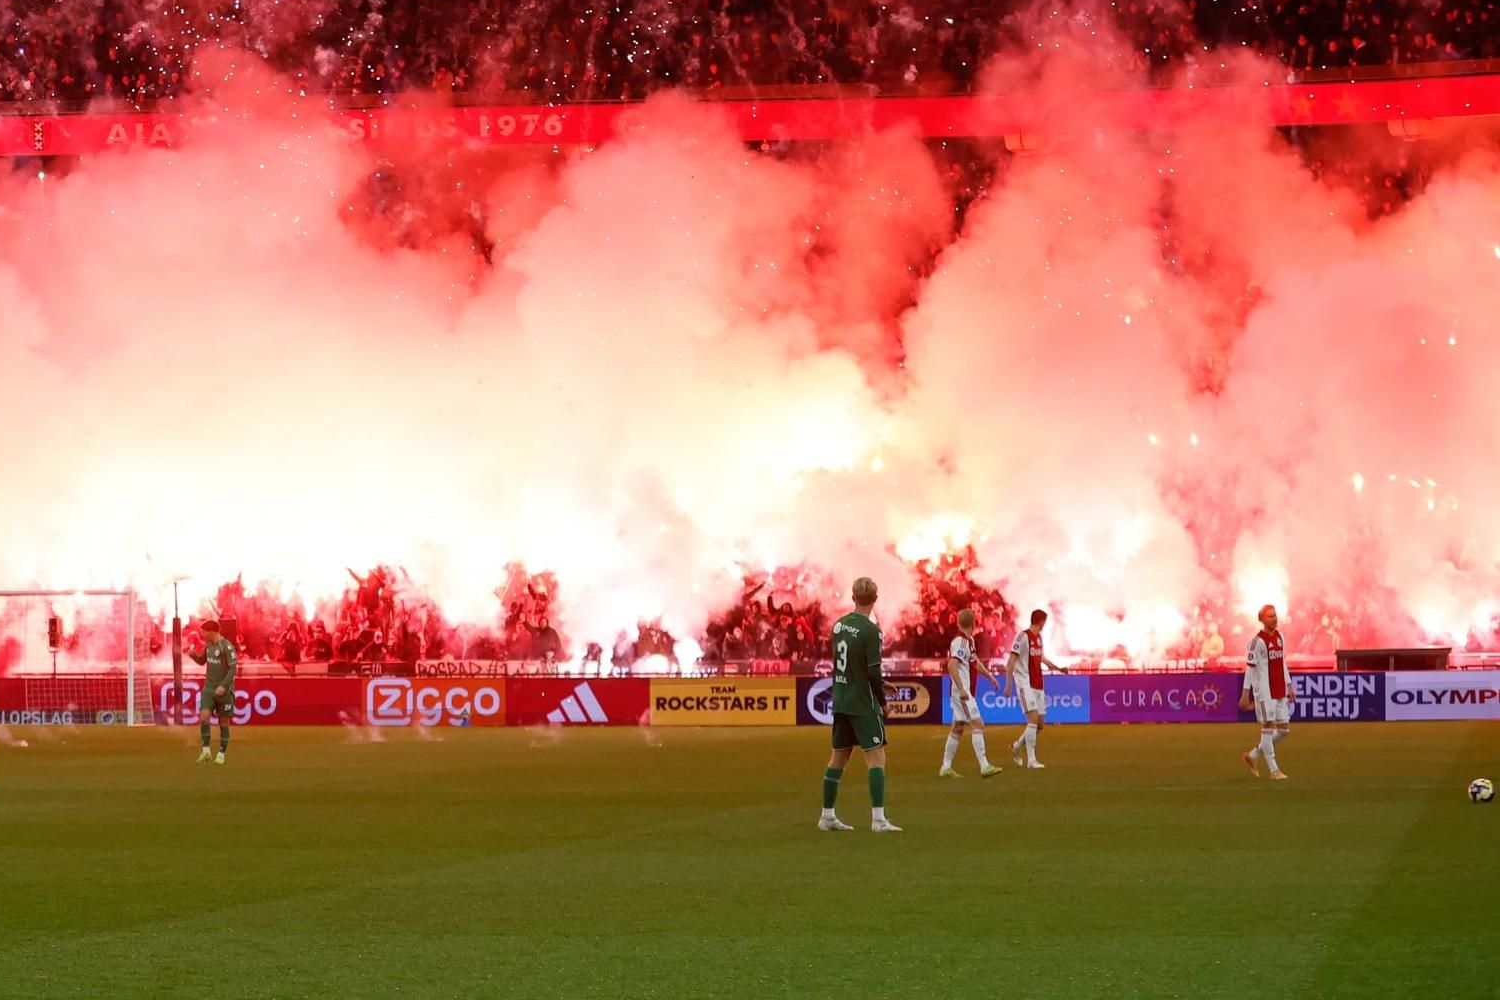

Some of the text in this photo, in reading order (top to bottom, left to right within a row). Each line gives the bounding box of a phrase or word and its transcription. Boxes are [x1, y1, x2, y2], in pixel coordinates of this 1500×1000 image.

[479, 104, 564, 137] 1976
[836, 640, 848, 673] 3
[710, 686, 737, 694] TEAM
[1103, 688, 1218, 710] CURAÇAO
[366, 677, 501, 726] Ziggo
[656, 696, 790, 711] ROCKSTARS IT
[11, 711, 74, 725] OPSLAG
